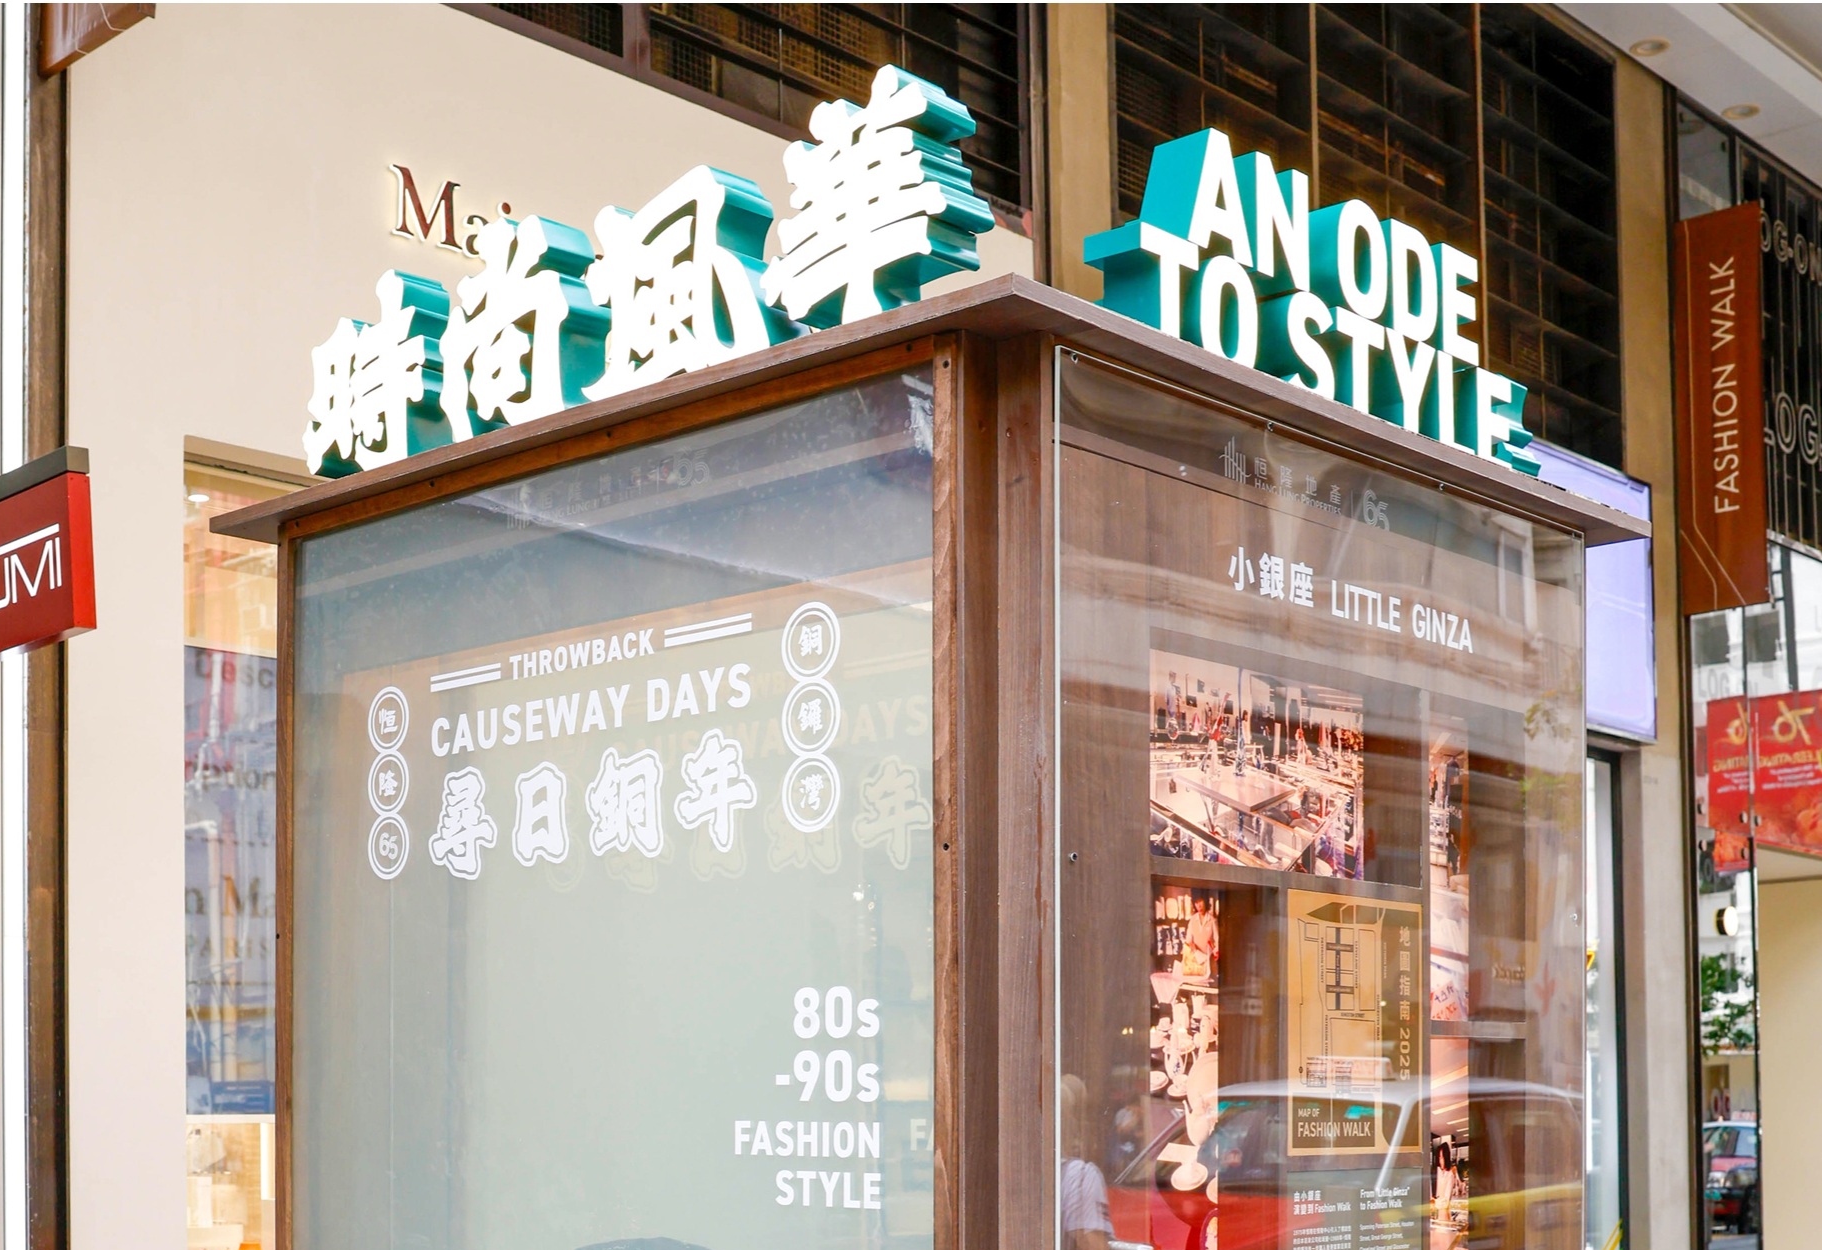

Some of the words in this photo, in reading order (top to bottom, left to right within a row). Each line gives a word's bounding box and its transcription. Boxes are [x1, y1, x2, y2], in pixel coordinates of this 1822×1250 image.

[304, 64, 951, 475] 時尚風華
[1188, 127, 1309, 293] AN
[1336, 199, 1479, 368] ODE
[1709, 256, 1737, 351] WALK
[1140, 221, 1257, 370] TO
[1288, 291, 1514, 472] STYLE
[1712, 363, 1740, 513] FASHION
[1363, 488, 1390, 532] 65
[1227, 546, 1315, 608] 小銀座
[1331, 579, 1401, 634] LITTLE
[1412, 603, 1474, 654] GINZA
[508, 628, 655, 681] THROWBACK
[430, 683, 630, 757] CAUSEWAY
[646, 663, 753, 724] DAYS
[798, 623, 826, 812] 銅鑼灣
[429, 728, 757, 881] 尋日銅年
[792, 985, 881, 1039] 80s
[774, 1049, 881, 1103] -90s
[1399, 1027, 1411, 1081] 2025
[734, 1120, 882, 1159] FASHION
[1297, 1121, 1340, 1138] FASHION
[1342, 1120, 1371, 1138] WALK
[1298, 1107, 1311, 1118] MAP
[1312, 1107, 1320, 1118] OF
[774, 1169, 882, 1210] STYLE
[1314, 1203, 1336, 1214] Fashion
[1337, 1201, 1351, 1212] Walk
[1360, 1189, 1375, 1199] From
[1366, 1200, 1387, 1210] Fashion
[1388, 1198, 1402, 1208] Walk
